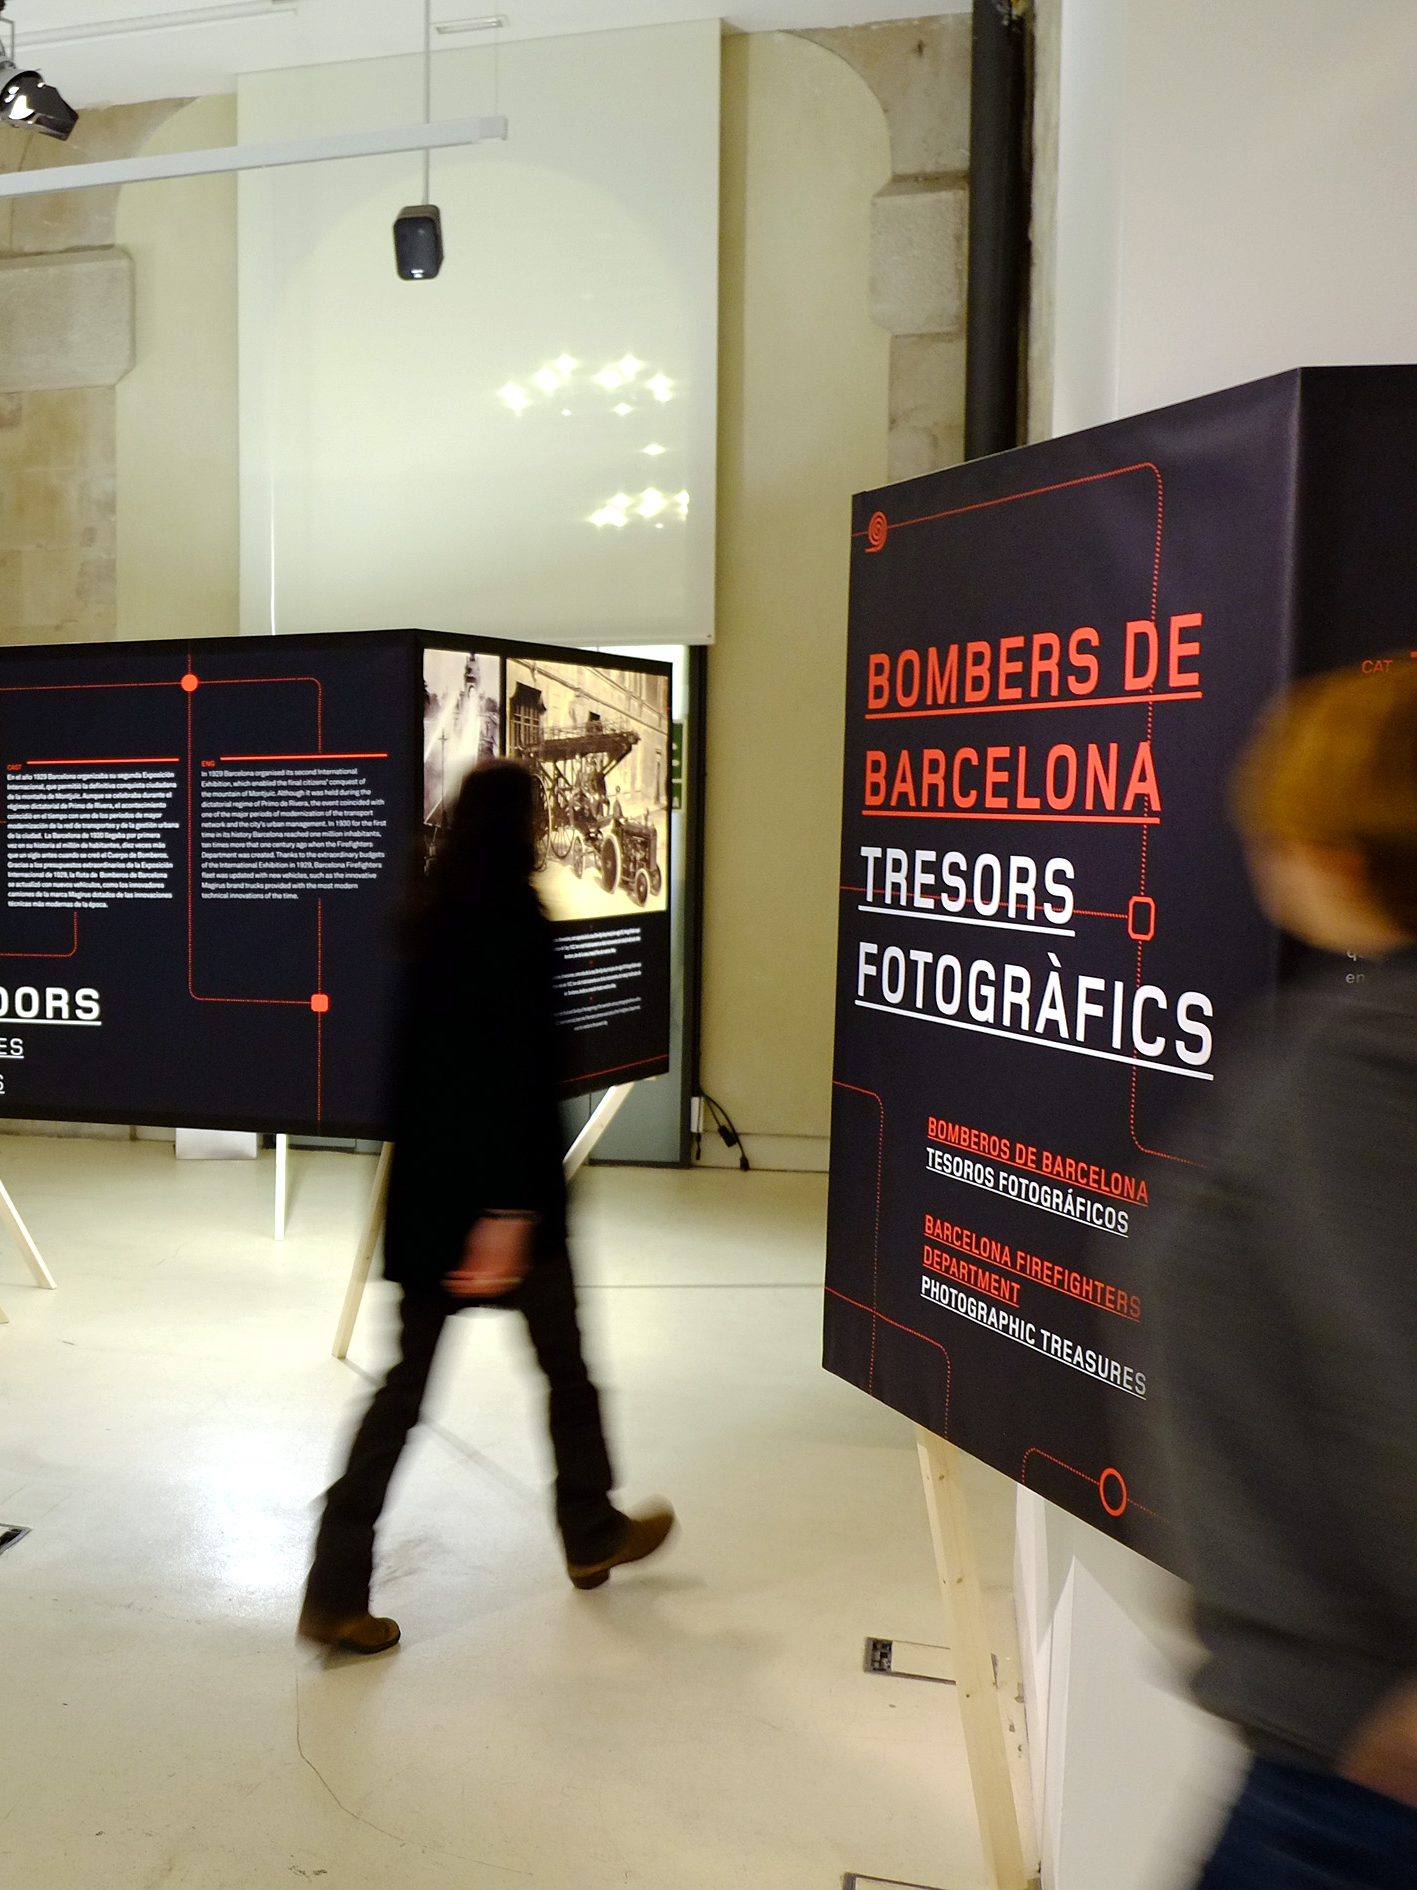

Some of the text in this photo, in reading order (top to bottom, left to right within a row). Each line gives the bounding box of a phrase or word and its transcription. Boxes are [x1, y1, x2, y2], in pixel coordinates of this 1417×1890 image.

[867, 612, 1203, 711] BOMBERS DE
[1361, 659, 1393, 674] CAT
[201, 800, 232, 808] dictatorial
[233, 801, 253, 809] regime
[254, 800, 260, 808] of
[310, 799, 322, 807] the
[340, 798, 370, 806] coincided
[224, 769, 254, 778] Barcelona
[295, 768, 317, 776] second
[318, 767, 358, 776] International
[277, 779, 287, 787] the
[329, 778, 358, 787] conquest
[359, 777, 366, 785] of
[278, 789, 304, 798] Although
[325, 788, 338, 796] held
[339, 789, 360, 797] during
[361, 788, 371, 796] the
[863, 741, 1162, 812] BARCELONA
[860, 845, 1075, 926] TRESORS
[855, 941, 1215, 1067] FOTOGRÀFICS
[926, 1147, 1129, 1234] TESOROS FOTOGRÁFICOS
[927, 1116, 1149, 1203] BOMBEROS DE BARCELONA
[923, 1245, 1021, 1303] DEPARTMENT
[924, 1215, 1142, 1318] BARCELONA FIREFIGHTERS
[921, 1276, 1147, 1396] PHOTOGRAPHIC TREASURES
